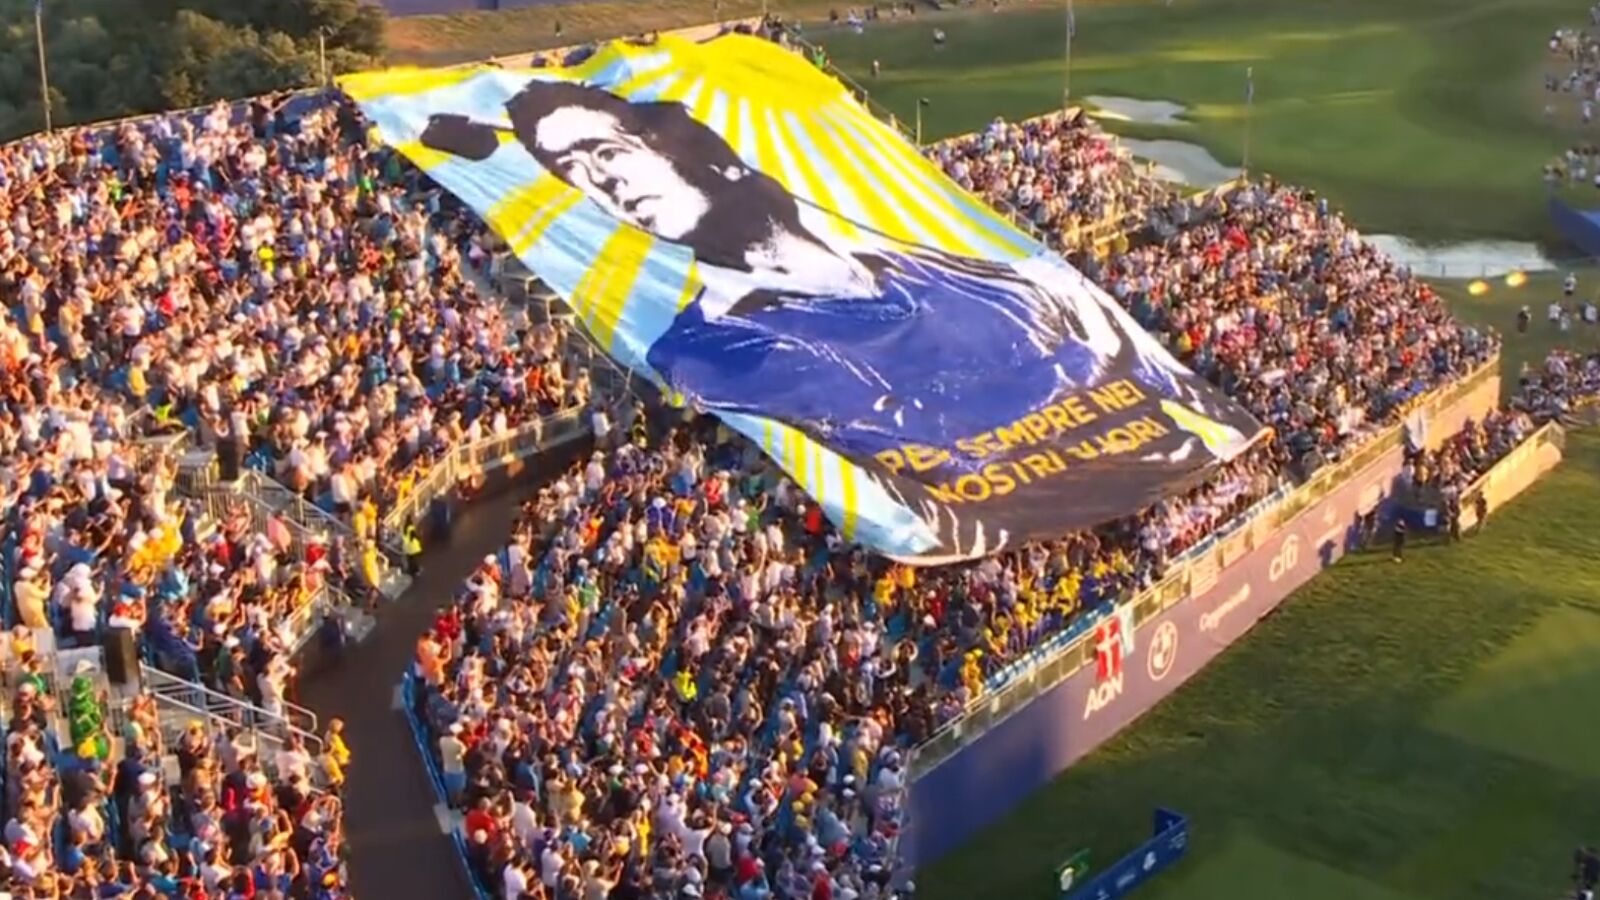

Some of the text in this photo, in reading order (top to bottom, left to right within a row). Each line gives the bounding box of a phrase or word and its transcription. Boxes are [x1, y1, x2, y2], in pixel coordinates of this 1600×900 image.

[874, 378, 1147, 477] PE SEMPRE NEI
[1083, 671, 1123, 720] AON
